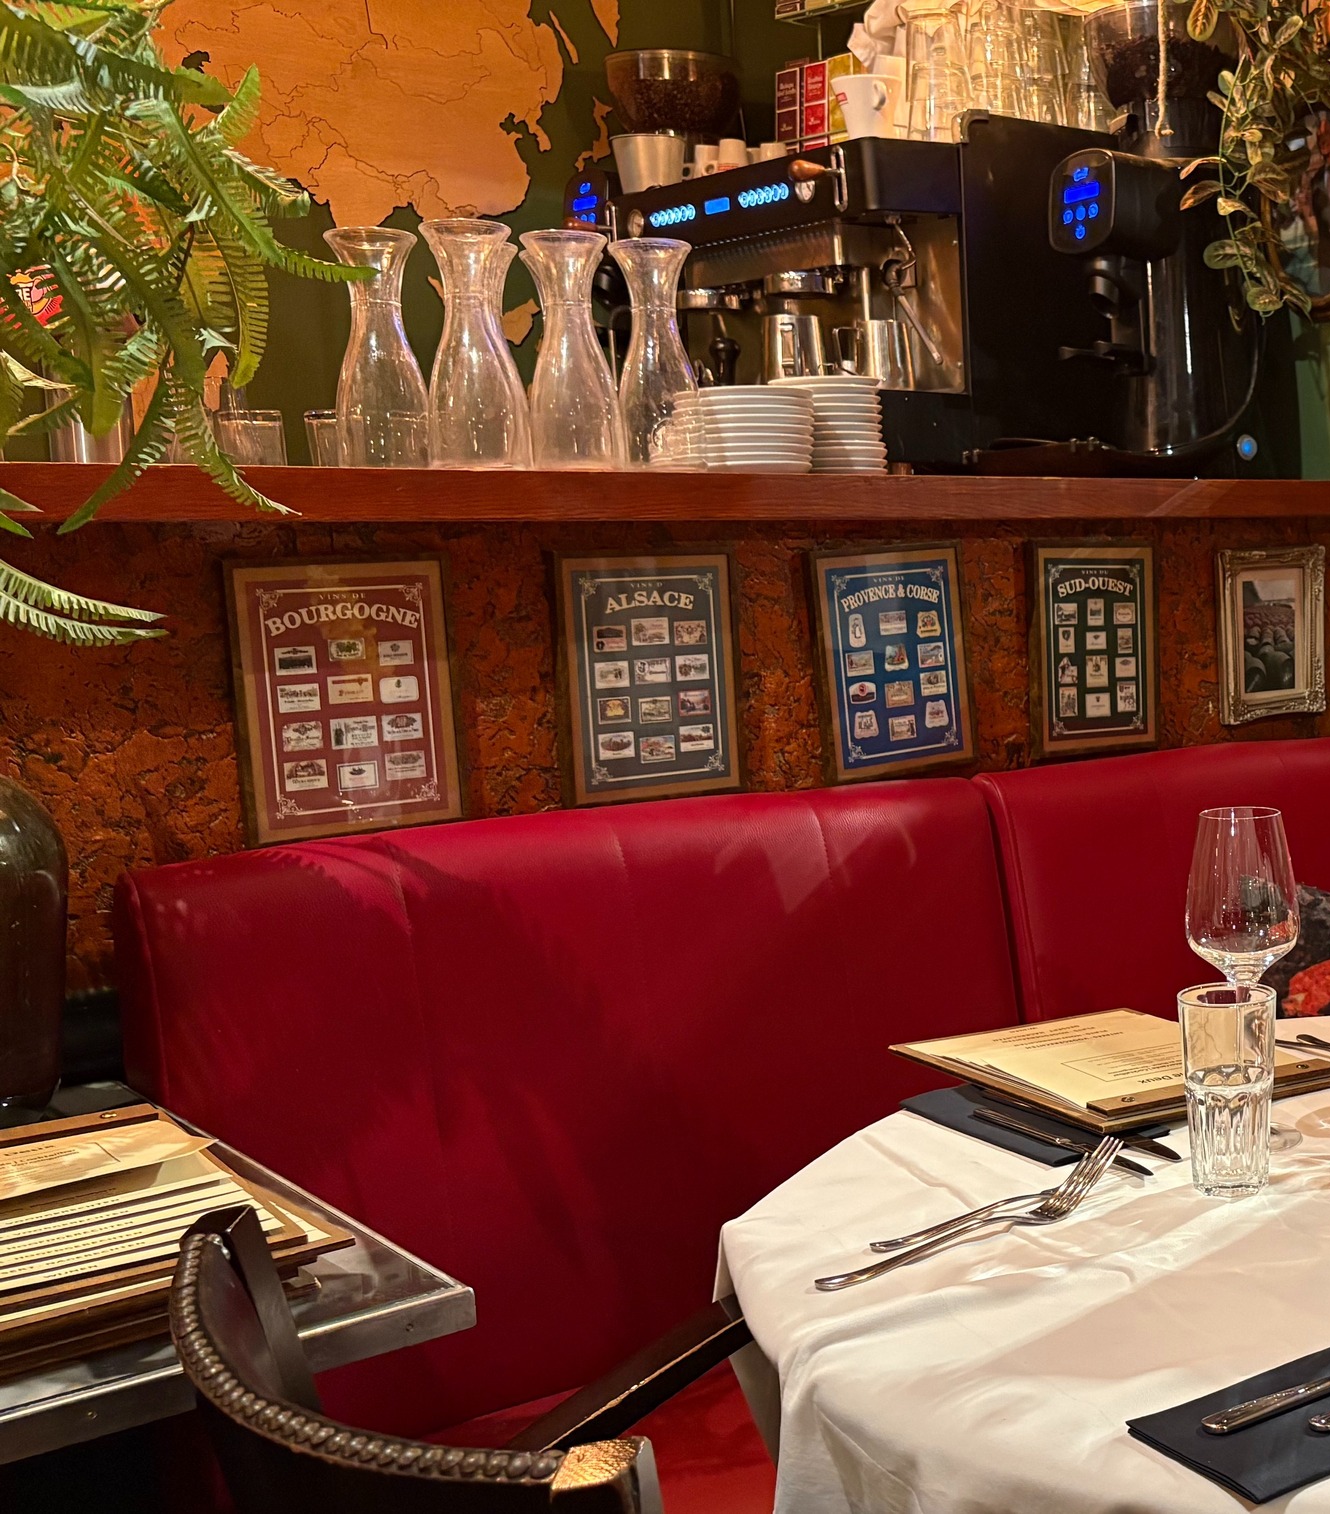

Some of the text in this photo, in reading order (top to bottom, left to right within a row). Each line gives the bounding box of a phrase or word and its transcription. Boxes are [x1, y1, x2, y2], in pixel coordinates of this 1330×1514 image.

[840, 584, 940, 613] PROVENCE & CORSE
[1057, 577, 1133, 597] SUD-OUEST
[605, 590, 694, 614] ALSACE
[265, 602, 420, 637] BOURGOGNE
